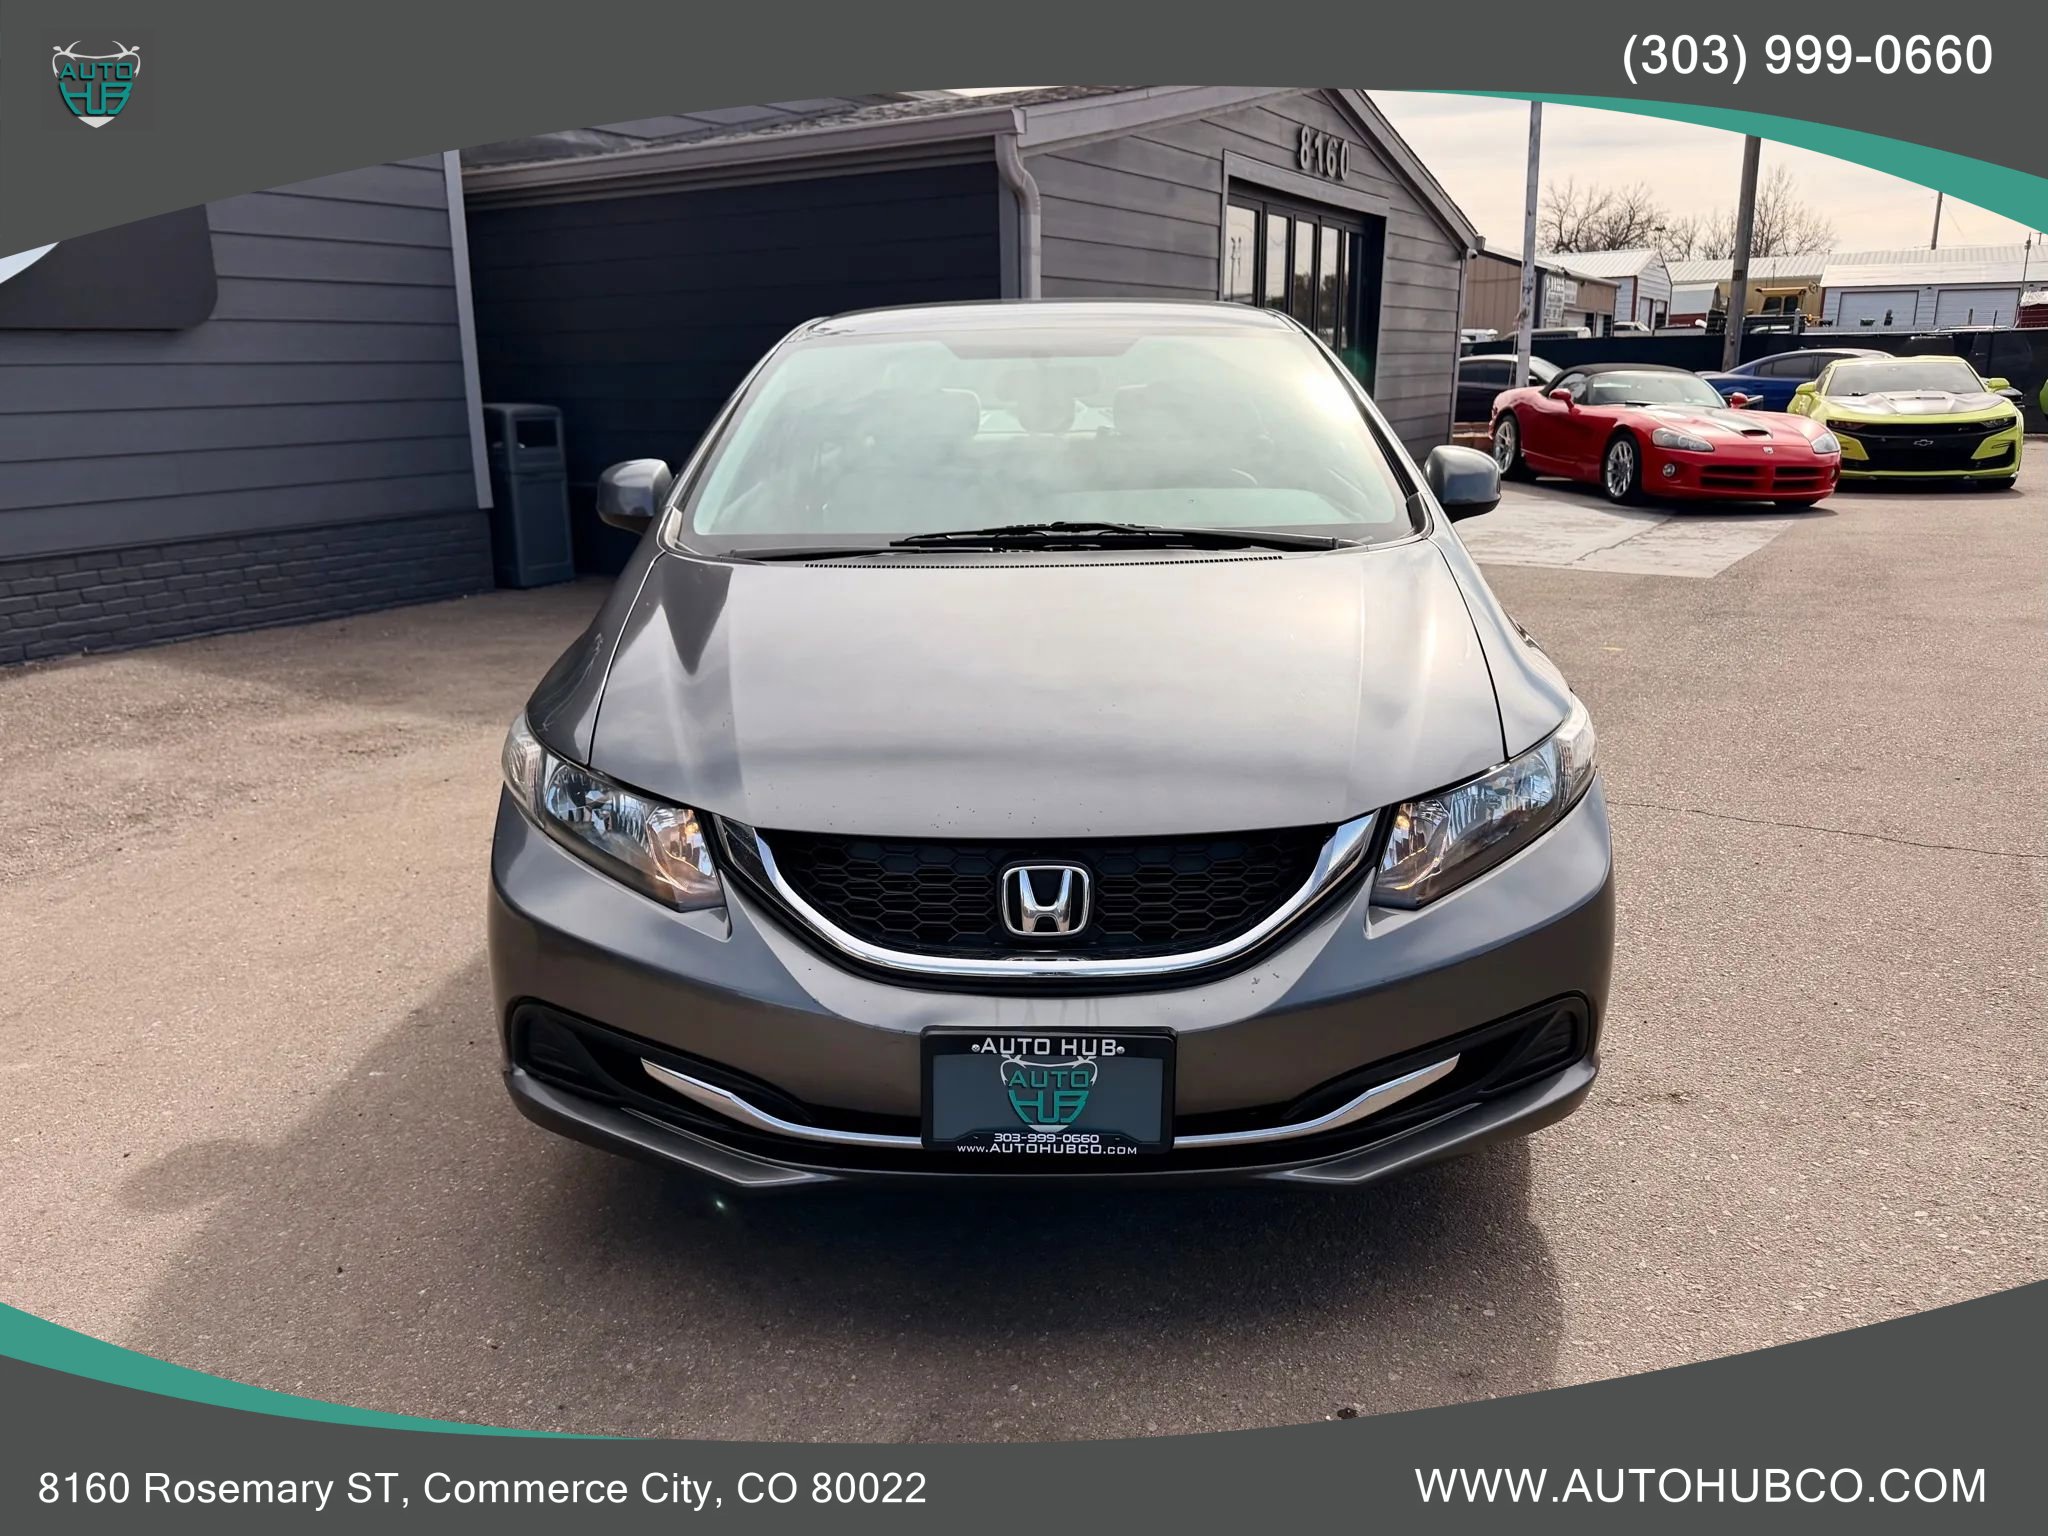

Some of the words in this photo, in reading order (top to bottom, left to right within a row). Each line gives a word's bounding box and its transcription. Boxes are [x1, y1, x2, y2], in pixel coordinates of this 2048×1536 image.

[1300, 125, 1350, 181] 8160
[980, 1037, 1050, 1055] AUTO
[1061, 1038, 1117, 1056] HUB
[1008, 1070, 1090, 1088] AUTO
[1008, 1089, 1090, 1124] HUB
[993, 1132, 1100, 1144] 303-999-0660
